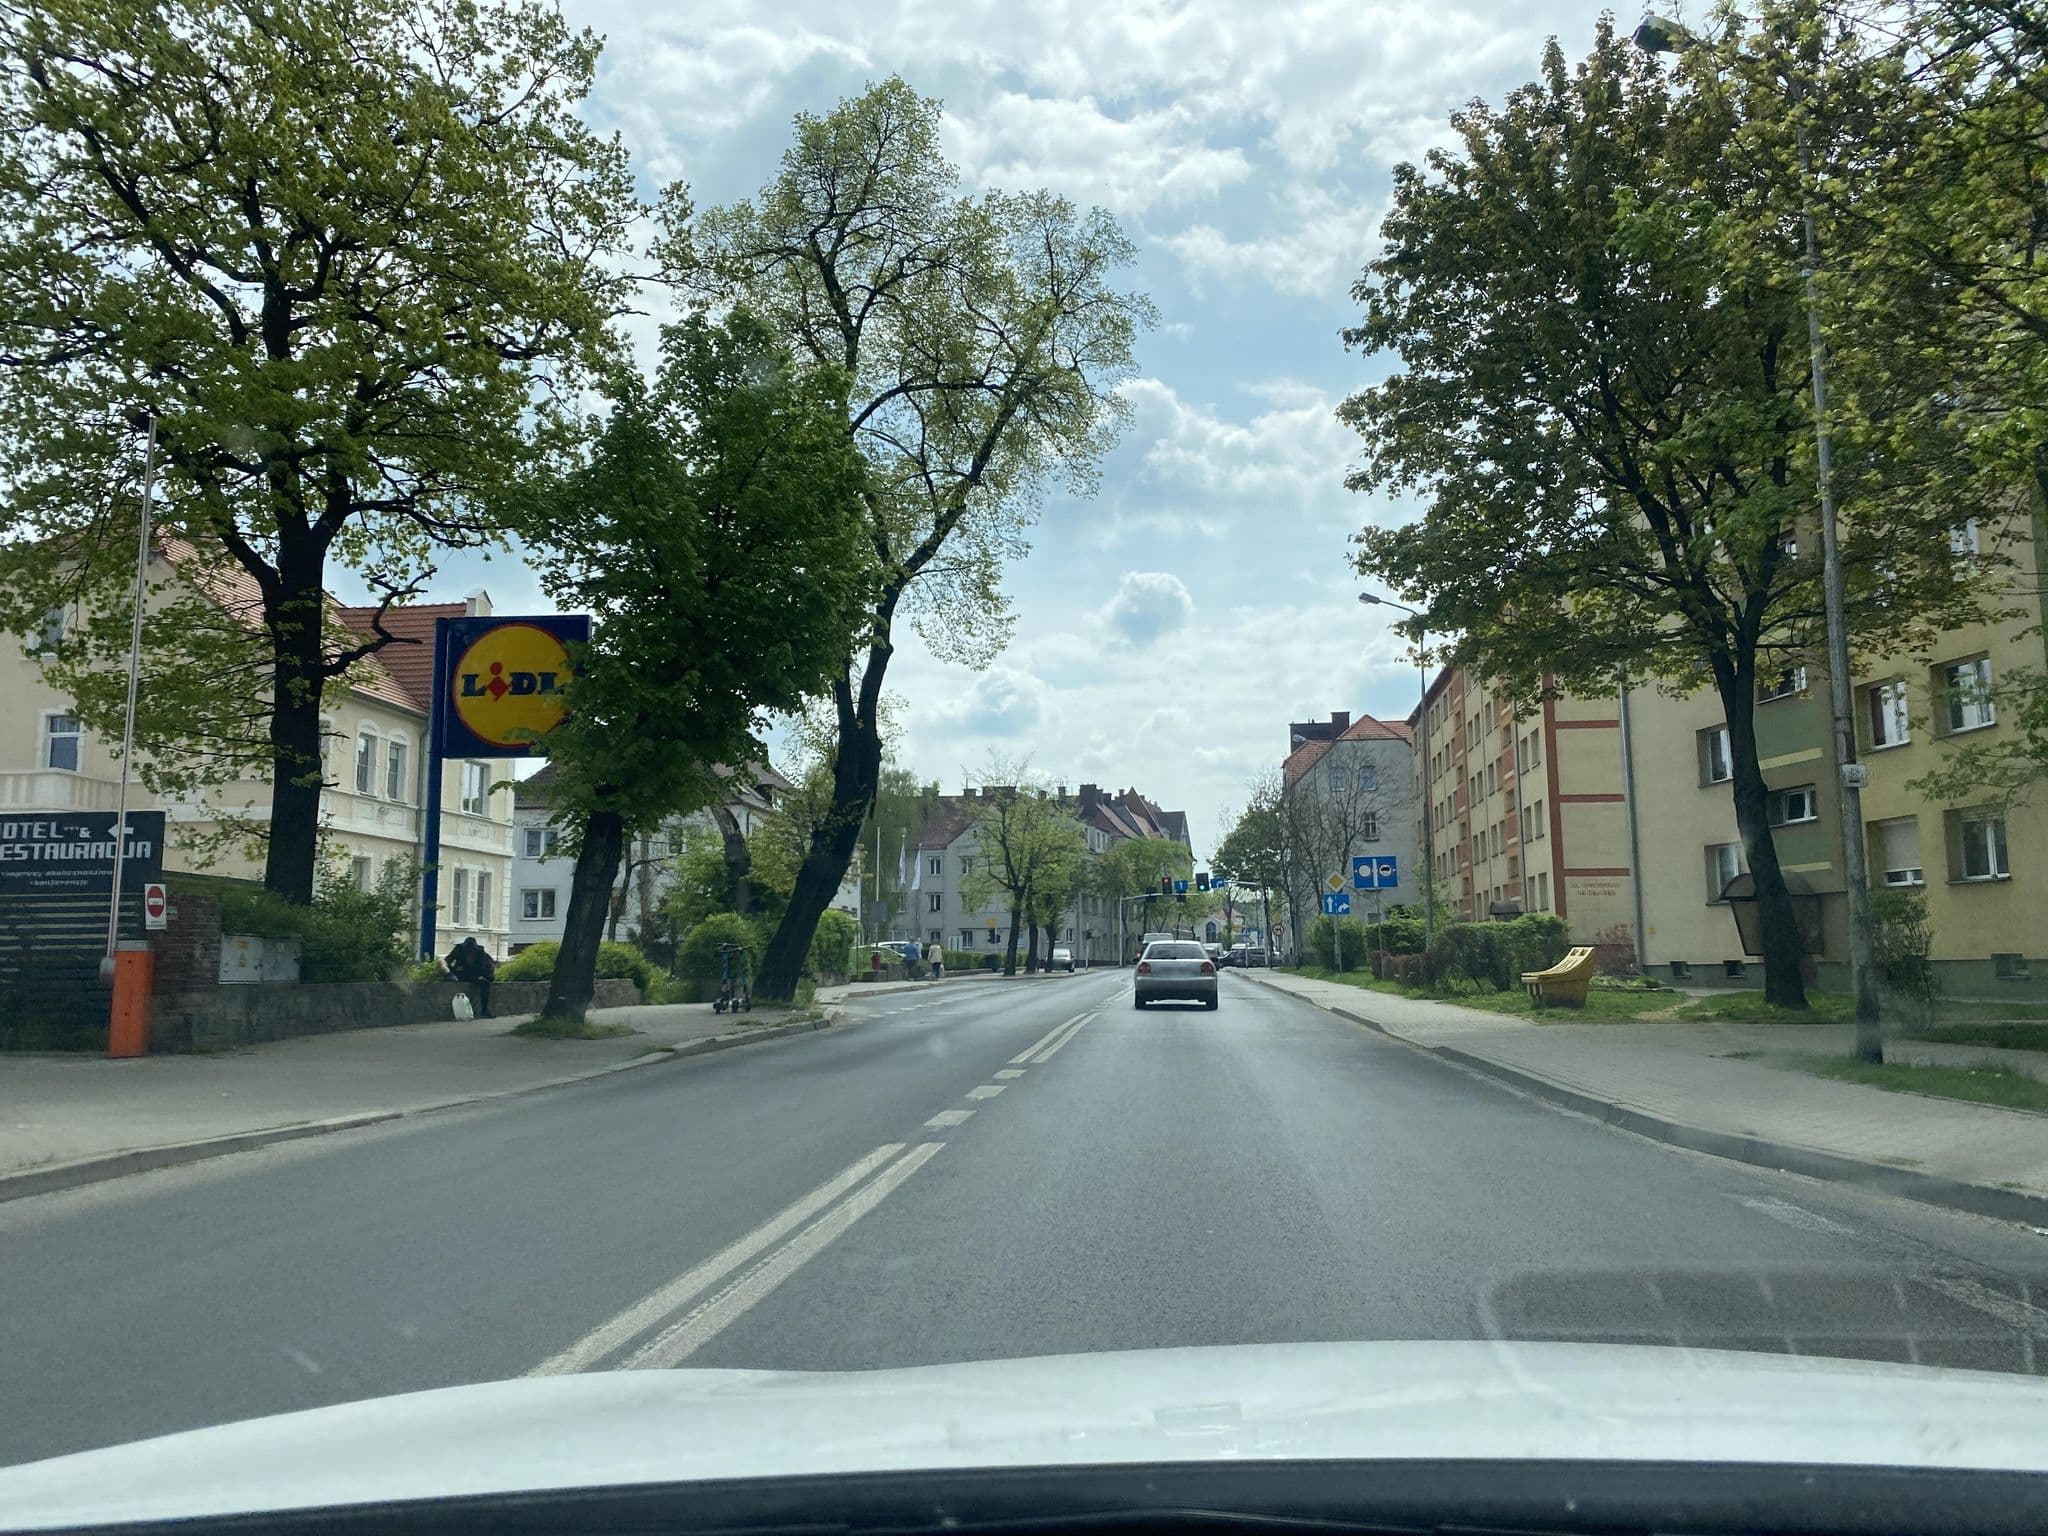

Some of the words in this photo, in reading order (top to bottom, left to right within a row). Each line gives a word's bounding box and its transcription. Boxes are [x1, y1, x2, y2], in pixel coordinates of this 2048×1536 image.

[0, 821, 64, 839] OTEL
[79, 826, 92, 838] &
[0, 841, 152, 860] ESTAURACJA
